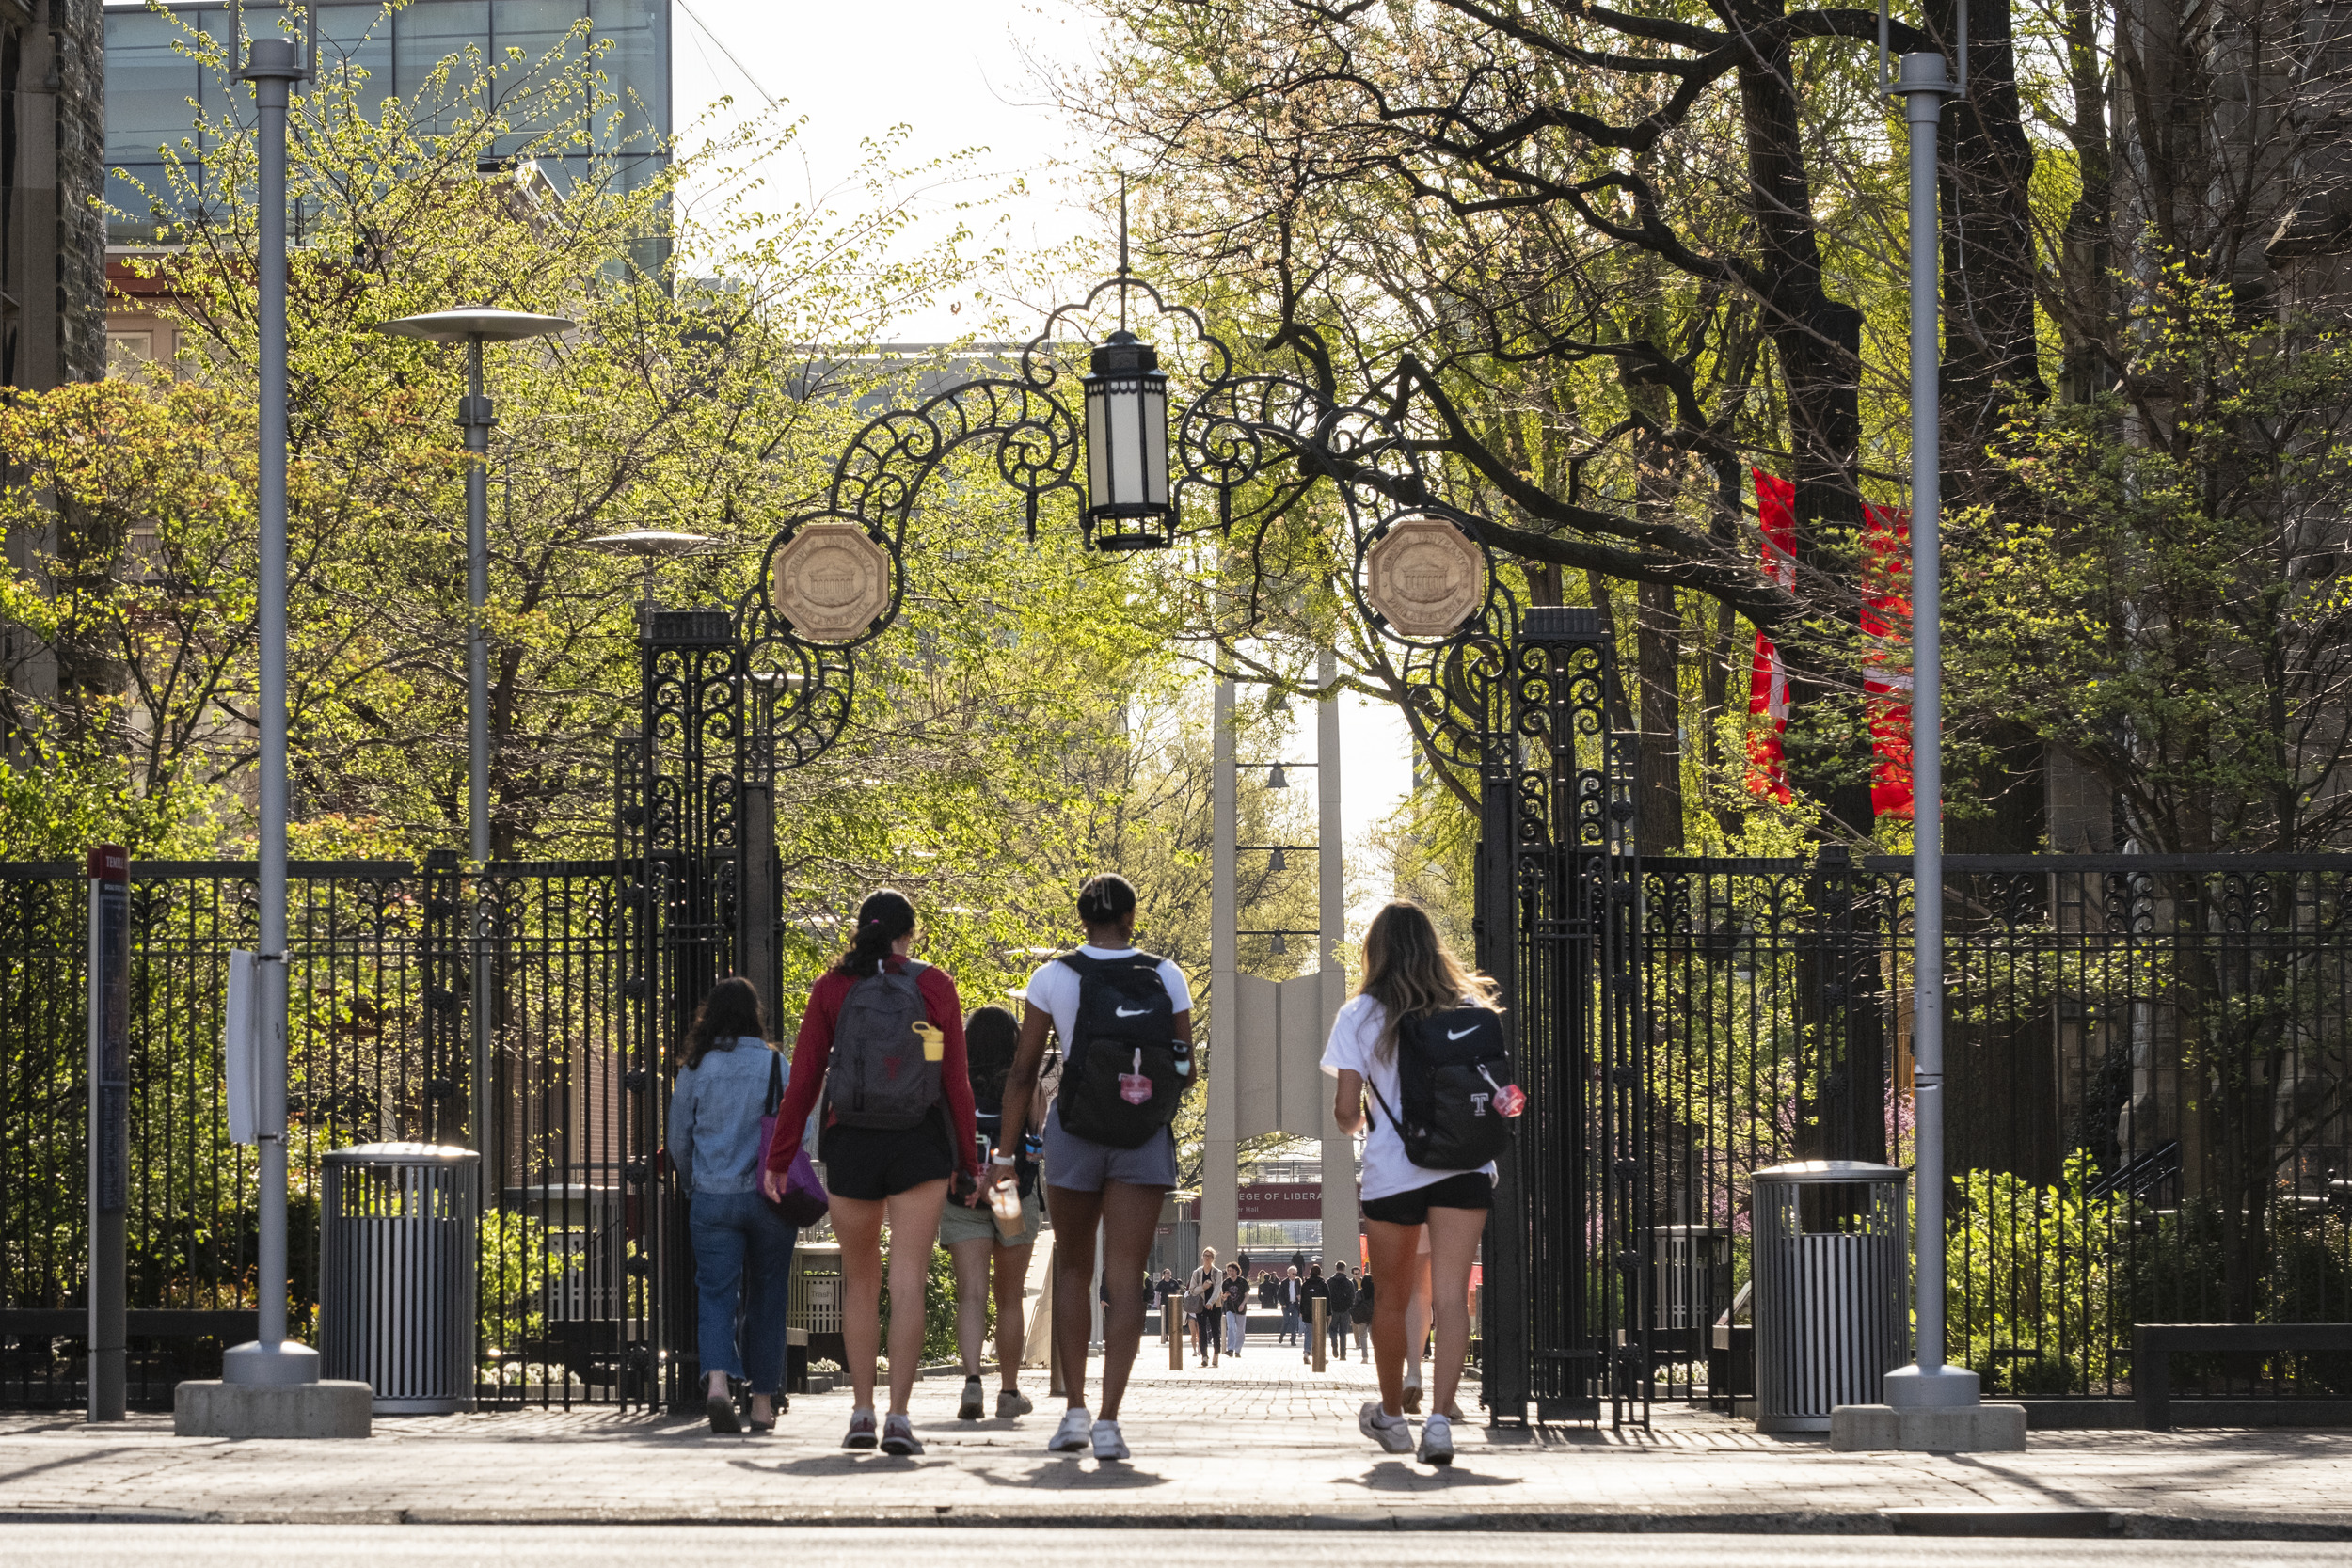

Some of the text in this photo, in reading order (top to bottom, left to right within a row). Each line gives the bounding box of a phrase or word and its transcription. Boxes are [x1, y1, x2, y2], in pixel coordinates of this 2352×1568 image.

[1470, 1092, 1489, 1117] T
[1239, 1193, 1322, 1201] EGE OF LIBERA
[811, 1290, 833, 1298] Trash
